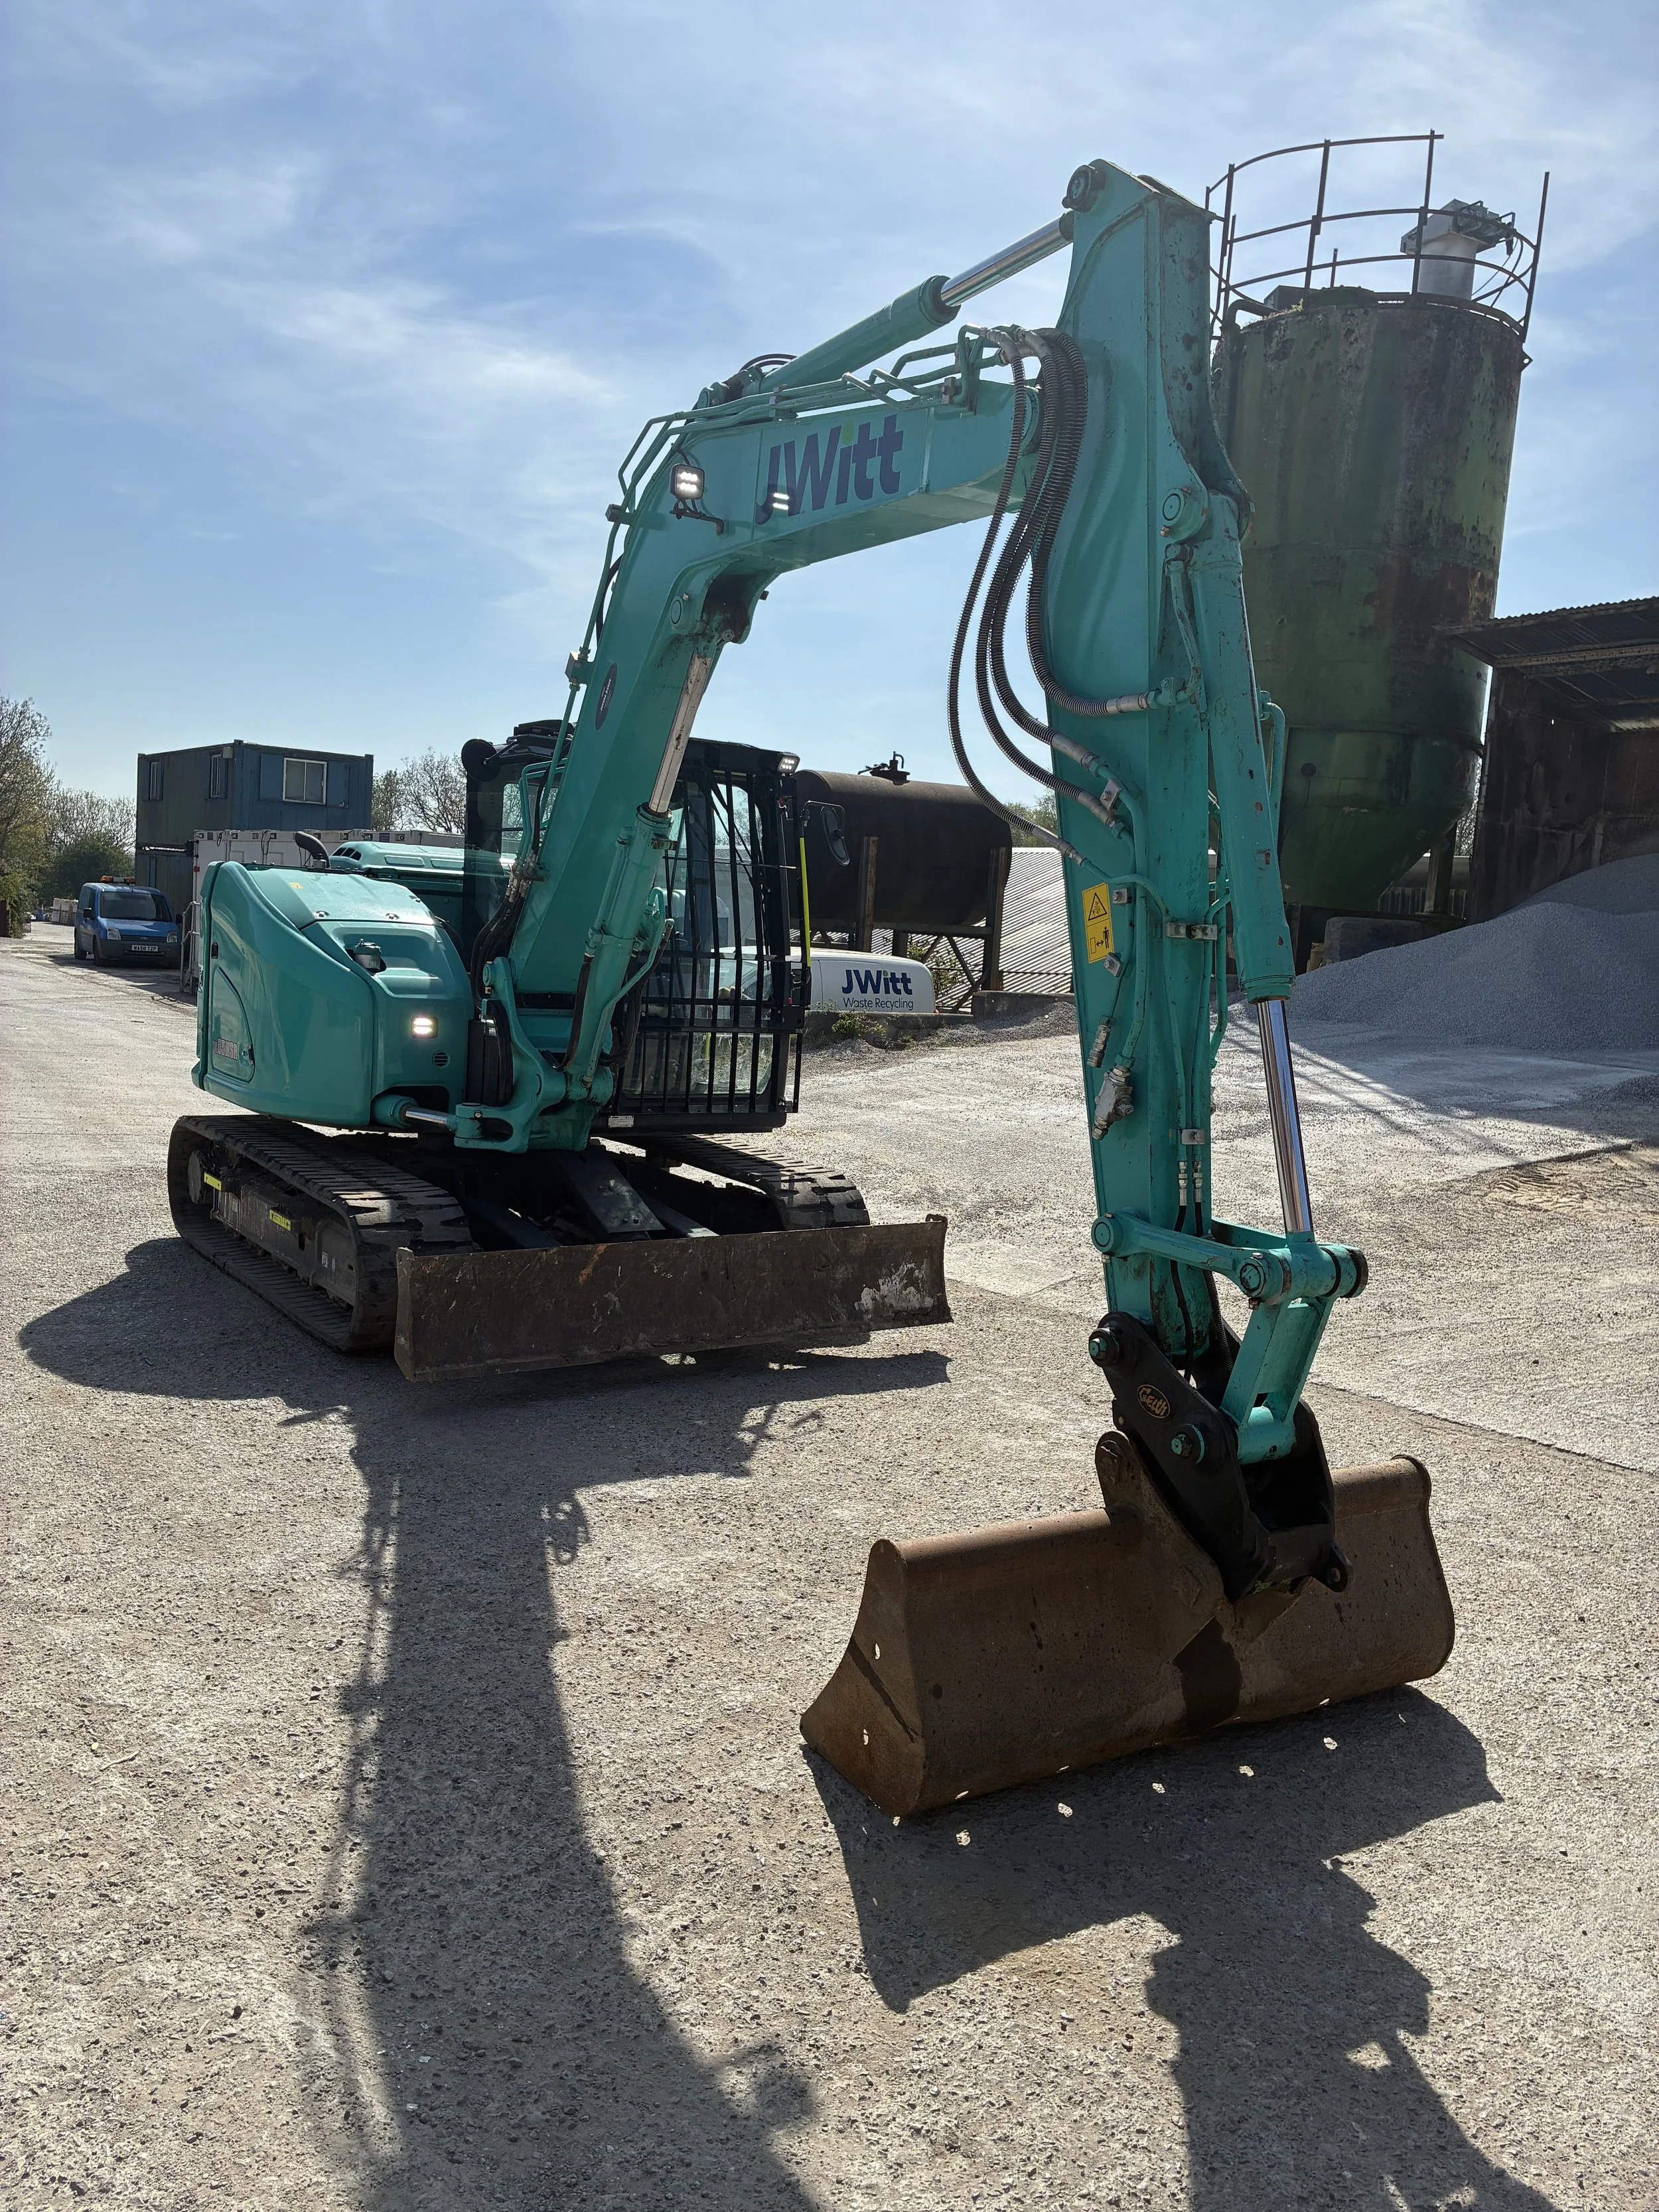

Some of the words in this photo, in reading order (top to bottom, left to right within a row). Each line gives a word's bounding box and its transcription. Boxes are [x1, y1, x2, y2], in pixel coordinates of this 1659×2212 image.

[755, 414, 904, 525] JWitt
[841, 970, 912, 995] JWitt
[843, 997, 873, 1008] Waste
[875, 998, 913, 1011] Recycling
